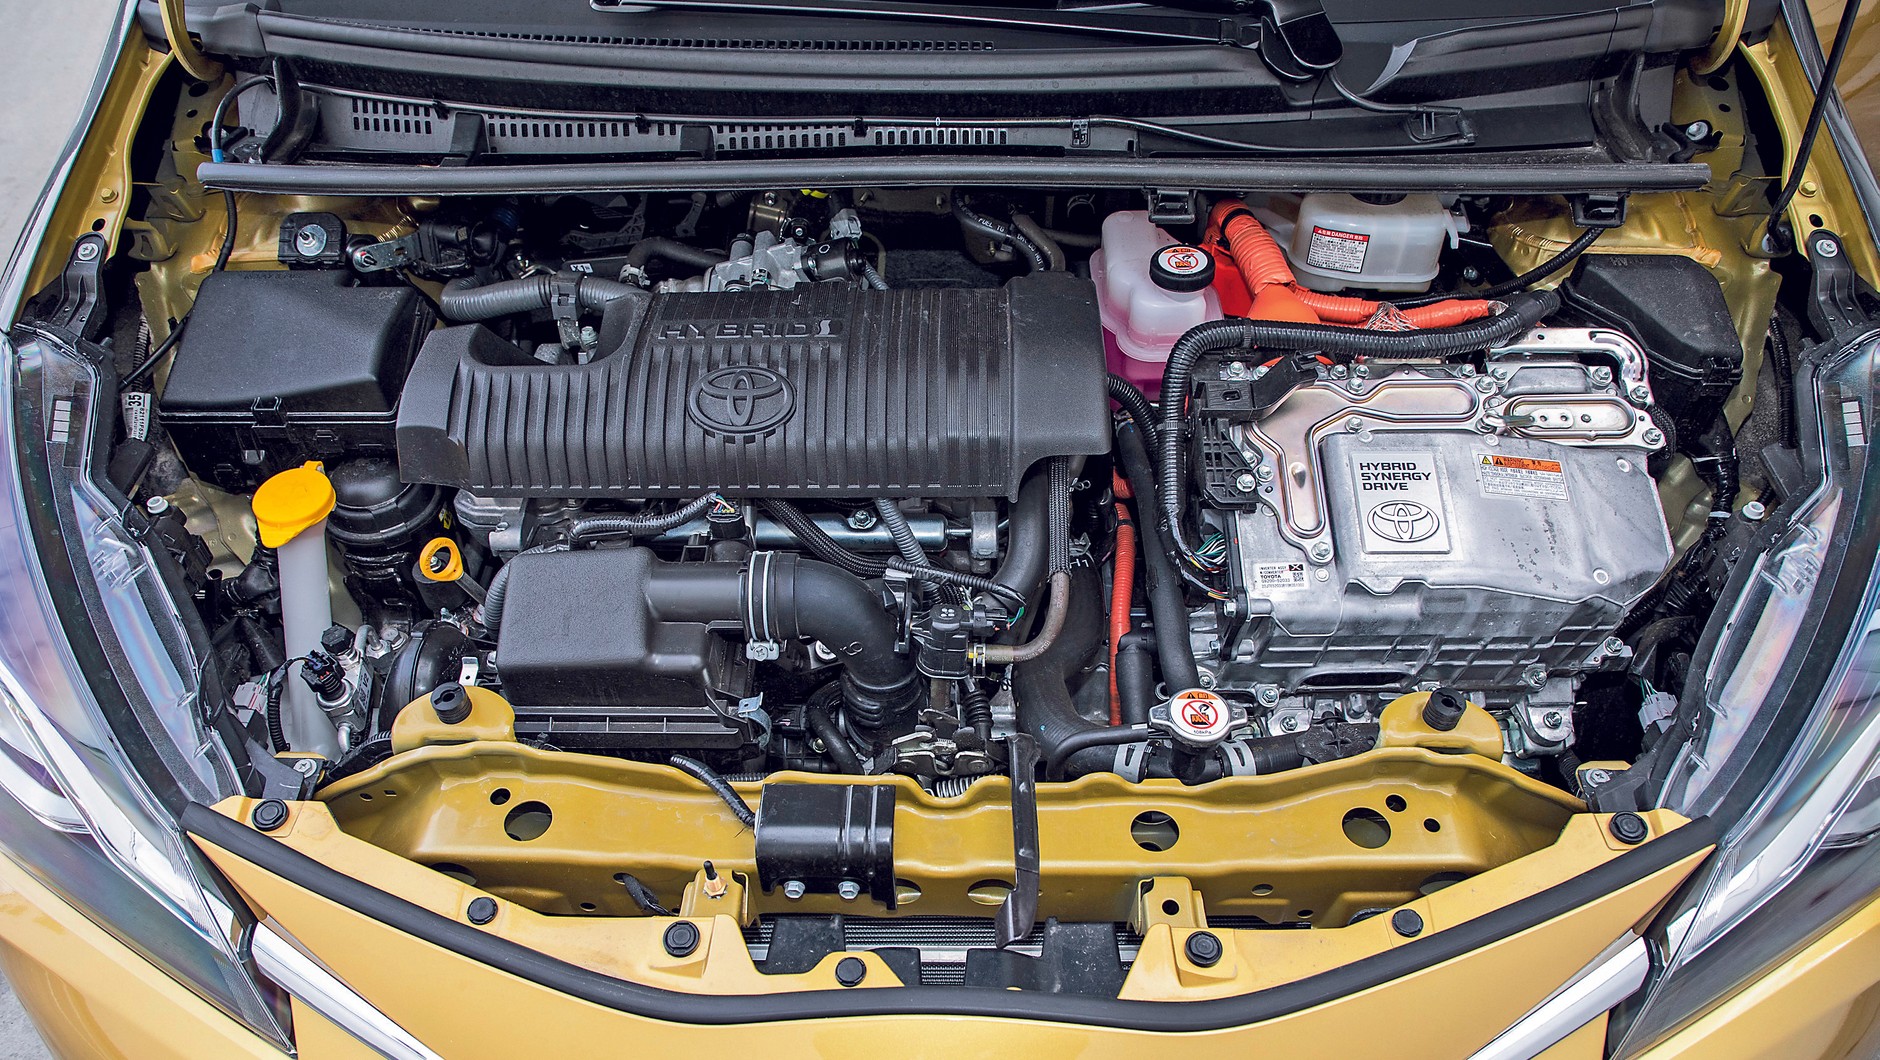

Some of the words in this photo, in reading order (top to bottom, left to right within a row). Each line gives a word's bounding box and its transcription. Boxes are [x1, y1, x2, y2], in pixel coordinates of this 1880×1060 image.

[1331, 231, 1354, 239] DANGER
[657, 323, 813, 340] HYBRID
[127, 394, 142, 407] 35
[1359, 462, 1417, 471] HYBRID
[1361, 472, 1432, 481] SYNERGY
[1363, 482, 1409, 491] DRIVE
